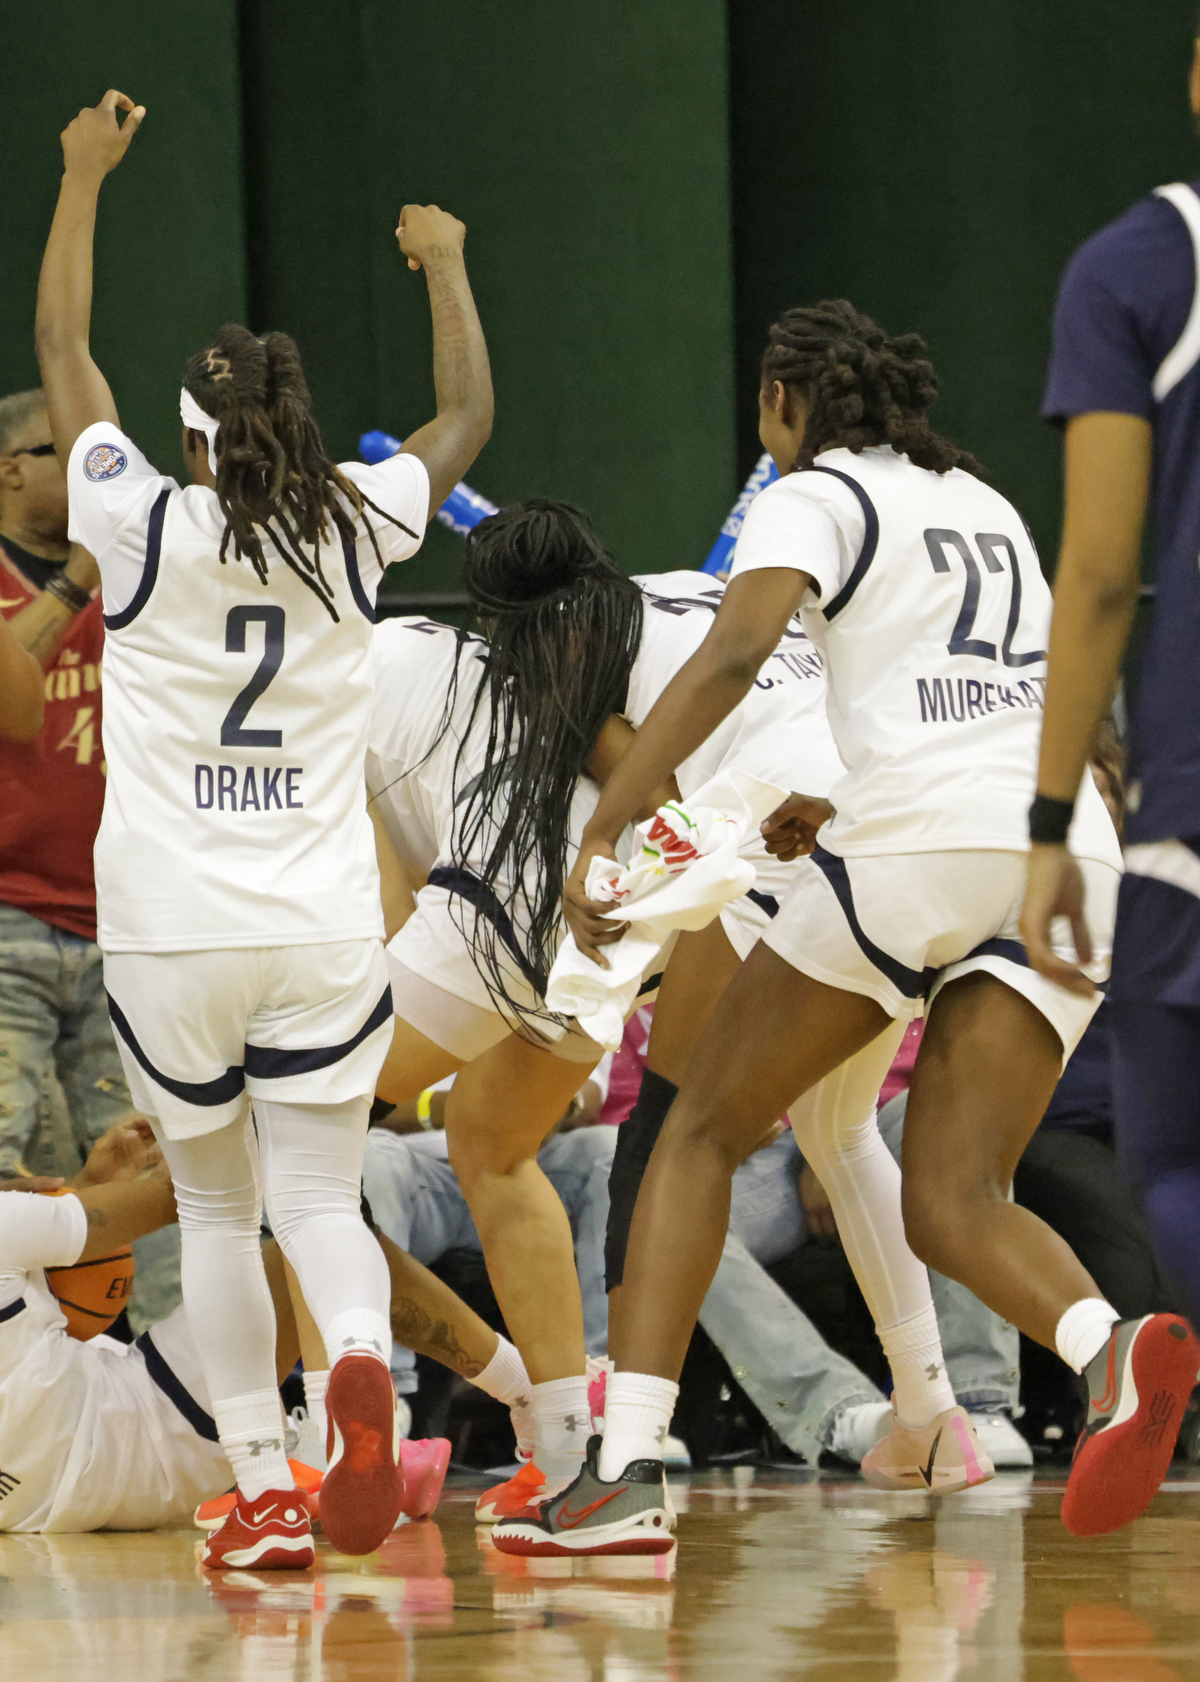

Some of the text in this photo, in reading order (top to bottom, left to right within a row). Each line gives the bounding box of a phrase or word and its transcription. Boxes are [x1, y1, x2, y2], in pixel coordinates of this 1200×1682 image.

[923, 528, 1049, 668] 22
[220, 605, 286, 748] 2
[194, 764, 304, 812] DRAKE
